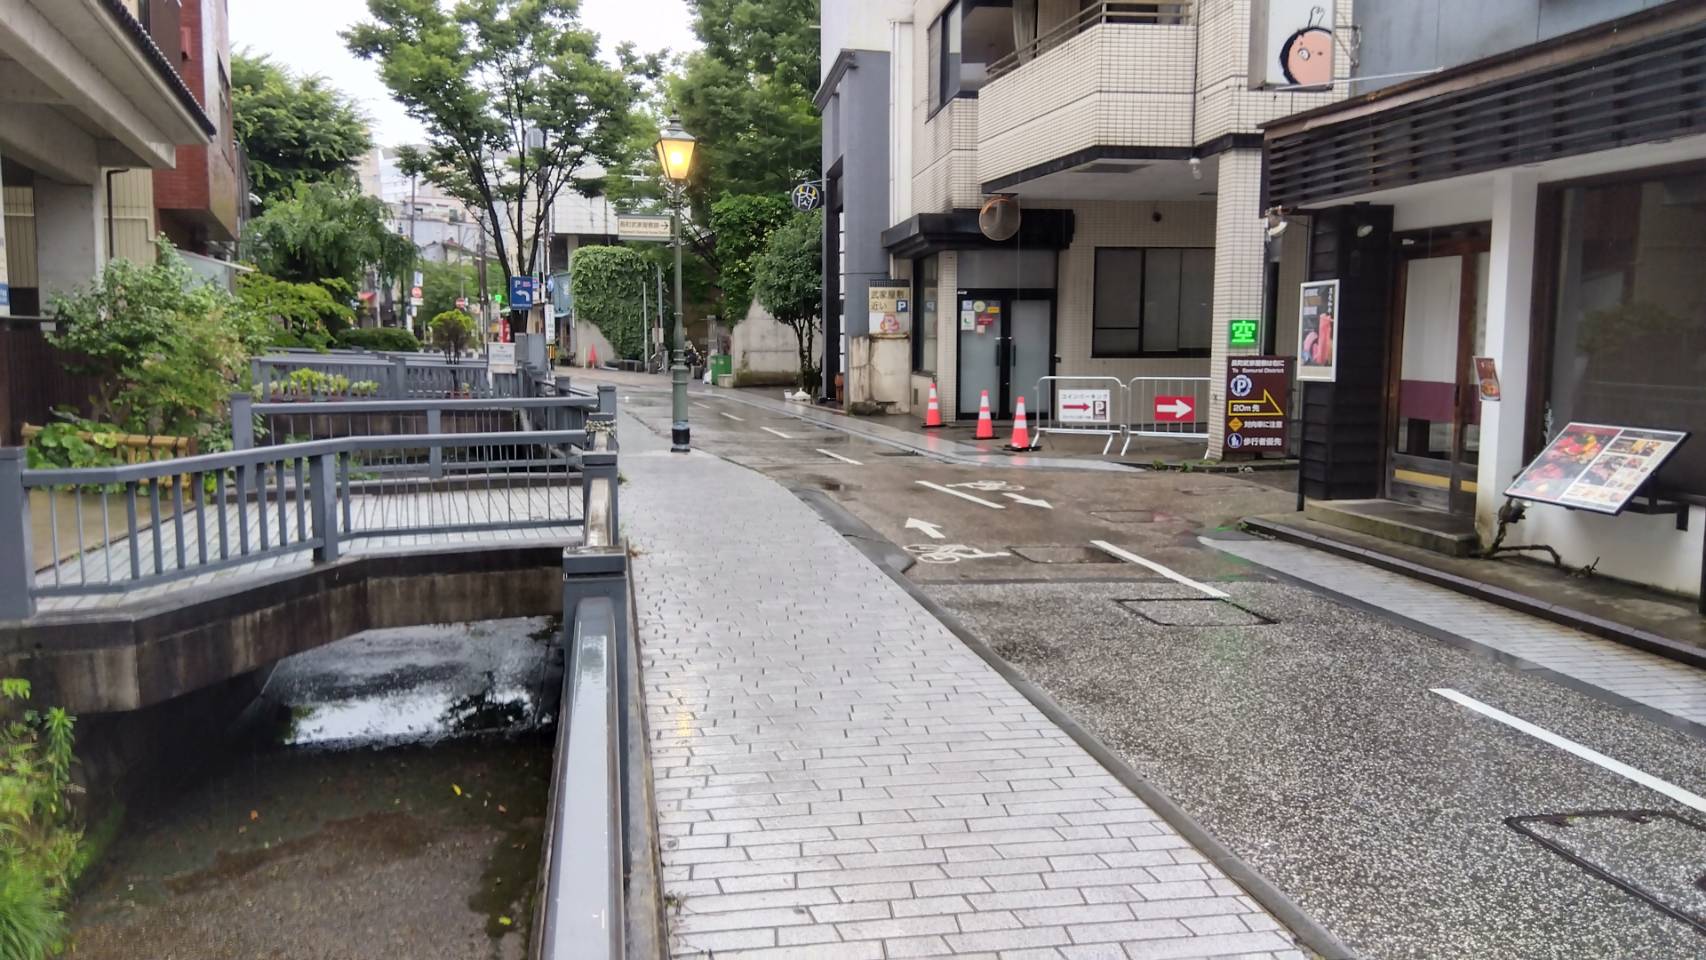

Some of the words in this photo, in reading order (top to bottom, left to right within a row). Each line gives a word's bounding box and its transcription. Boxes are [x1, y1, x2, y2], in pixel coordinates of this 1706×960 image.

[897, 301, 906, 311] P
[1231, 320, 1256, 343] 空
[1237, 380, 1247, 393] P
[1233, 404, 1251, 412] 20m
[1243, 437, 1282, 446] 歩行者優先
